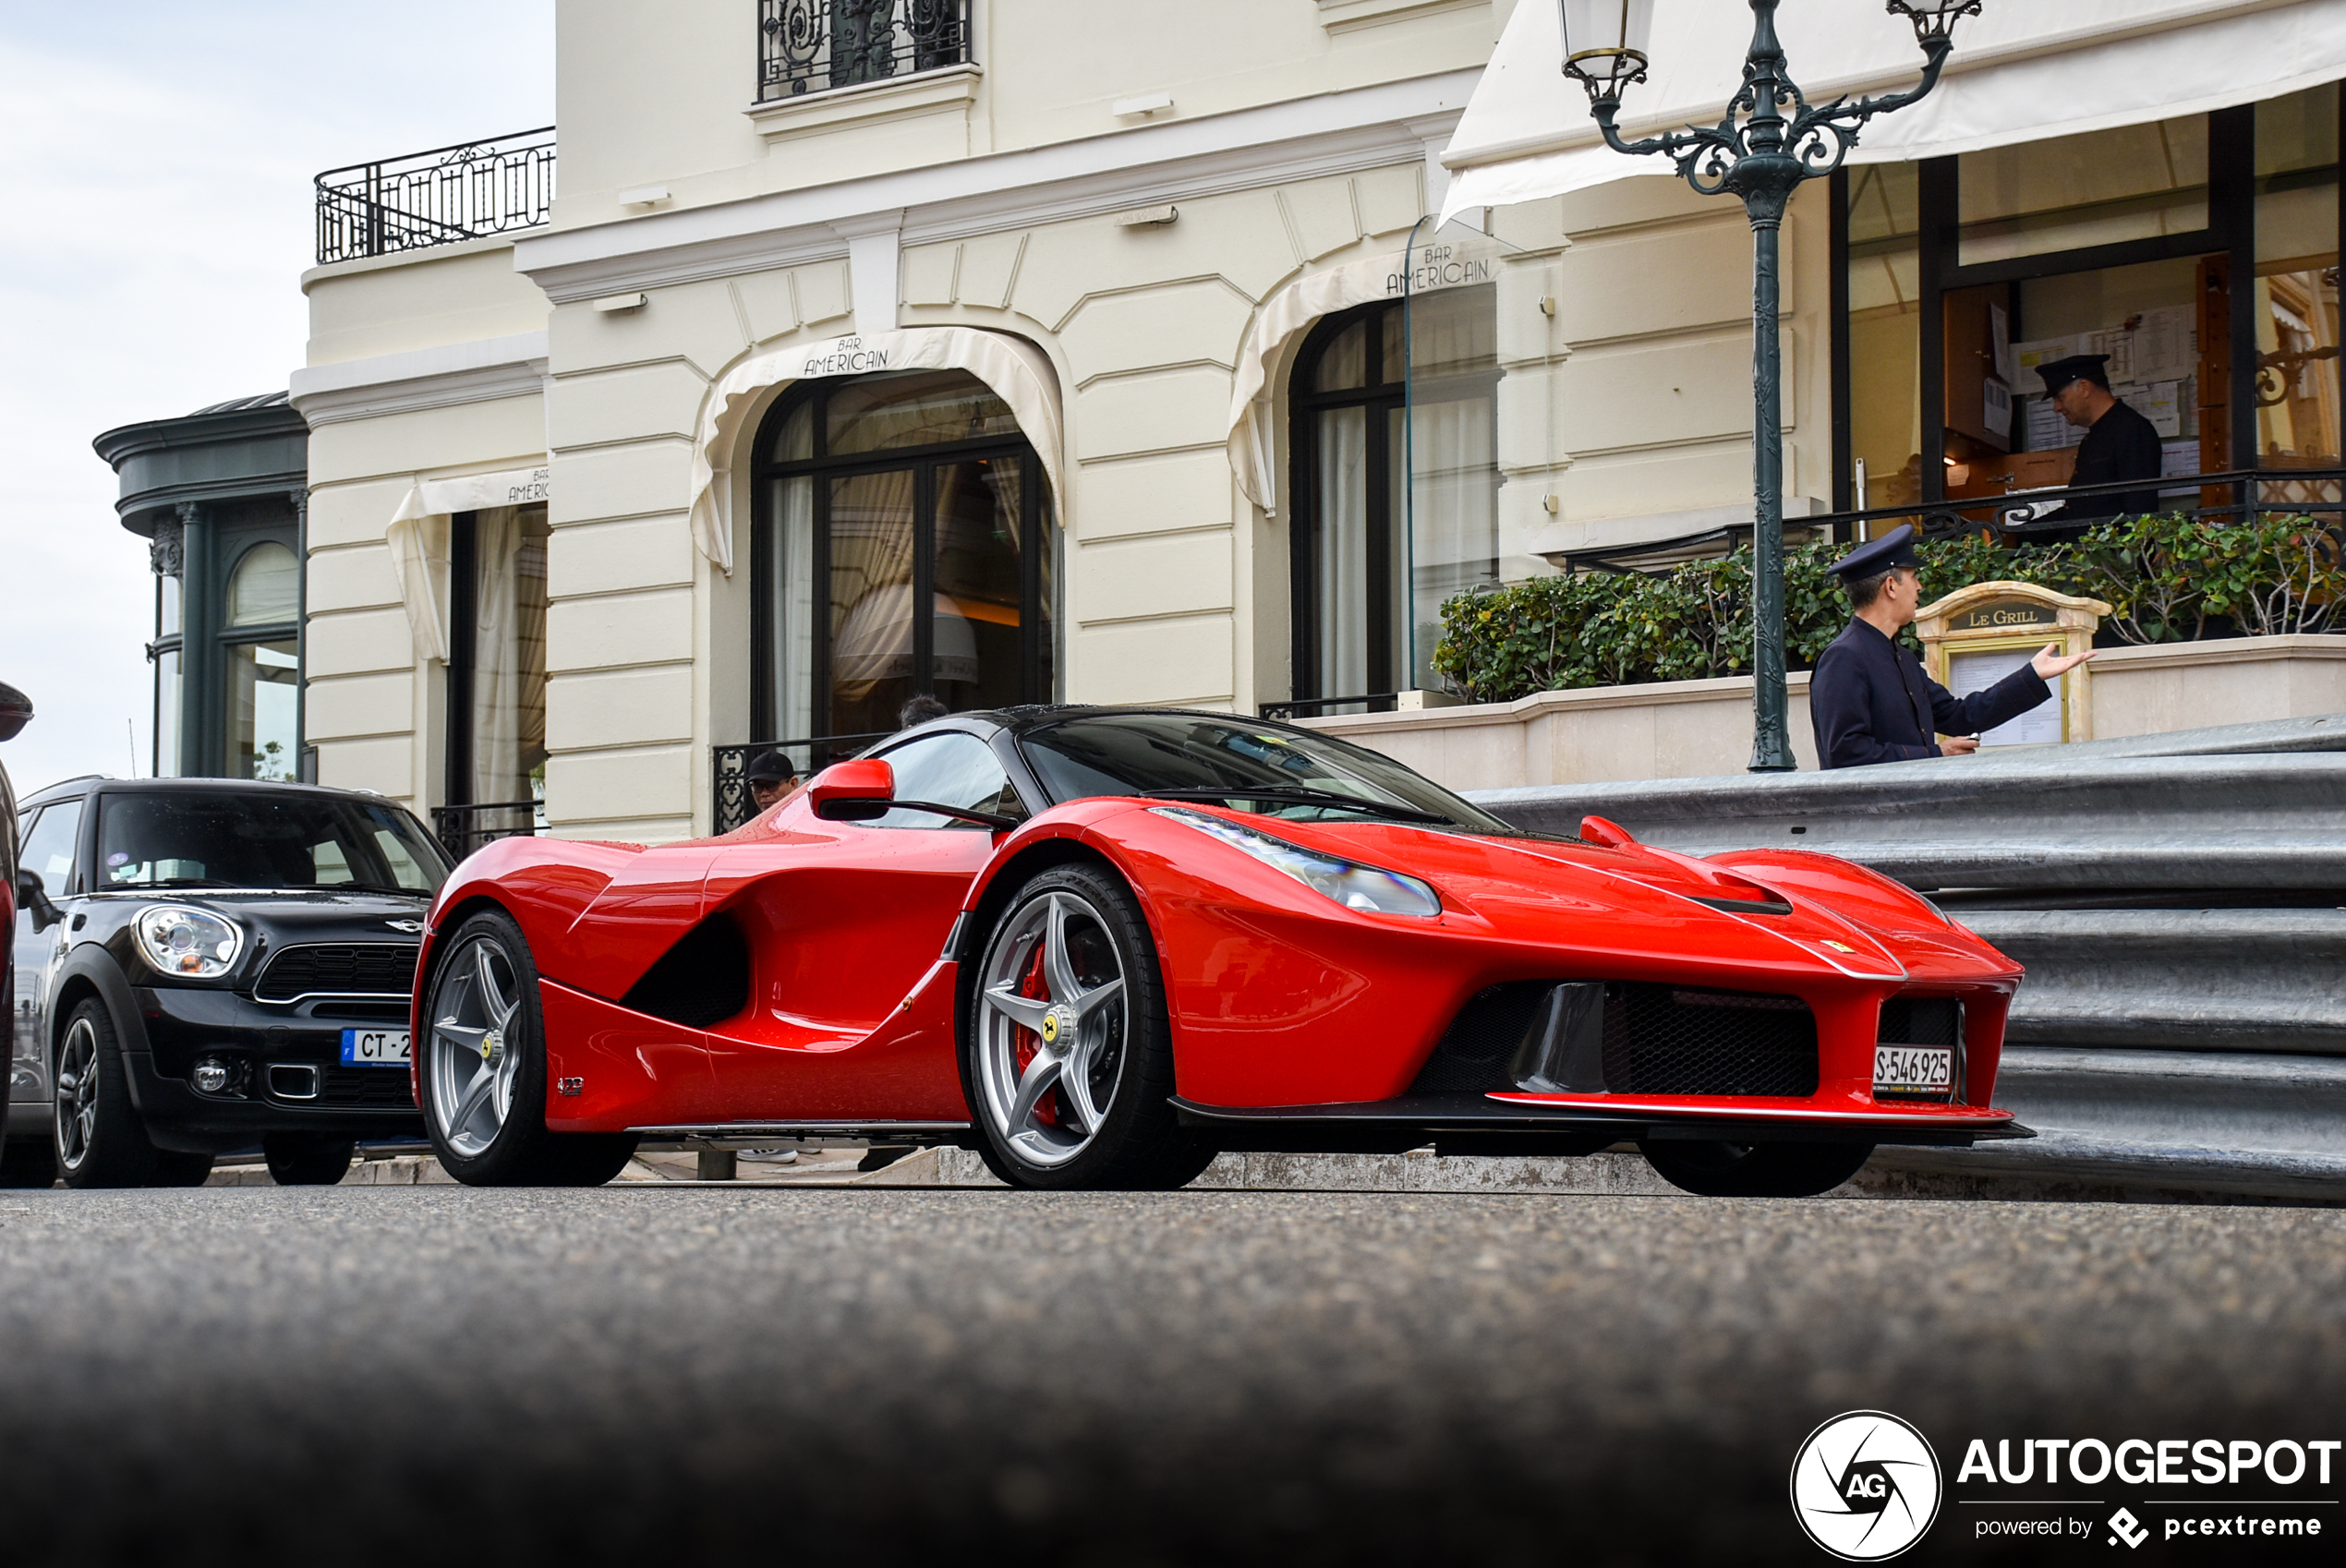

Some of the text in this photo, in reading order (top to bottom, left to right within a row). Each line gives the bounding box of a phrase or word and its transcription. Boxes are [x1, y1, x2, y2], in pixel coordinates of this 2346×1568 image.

[1425, 246, 1452, 264] BAR
[1386, 259, 1488, 294] AMERICAIN
[838, 337, 862, 351] BAR
[804, 350, 889, 375] AMERICAIN
